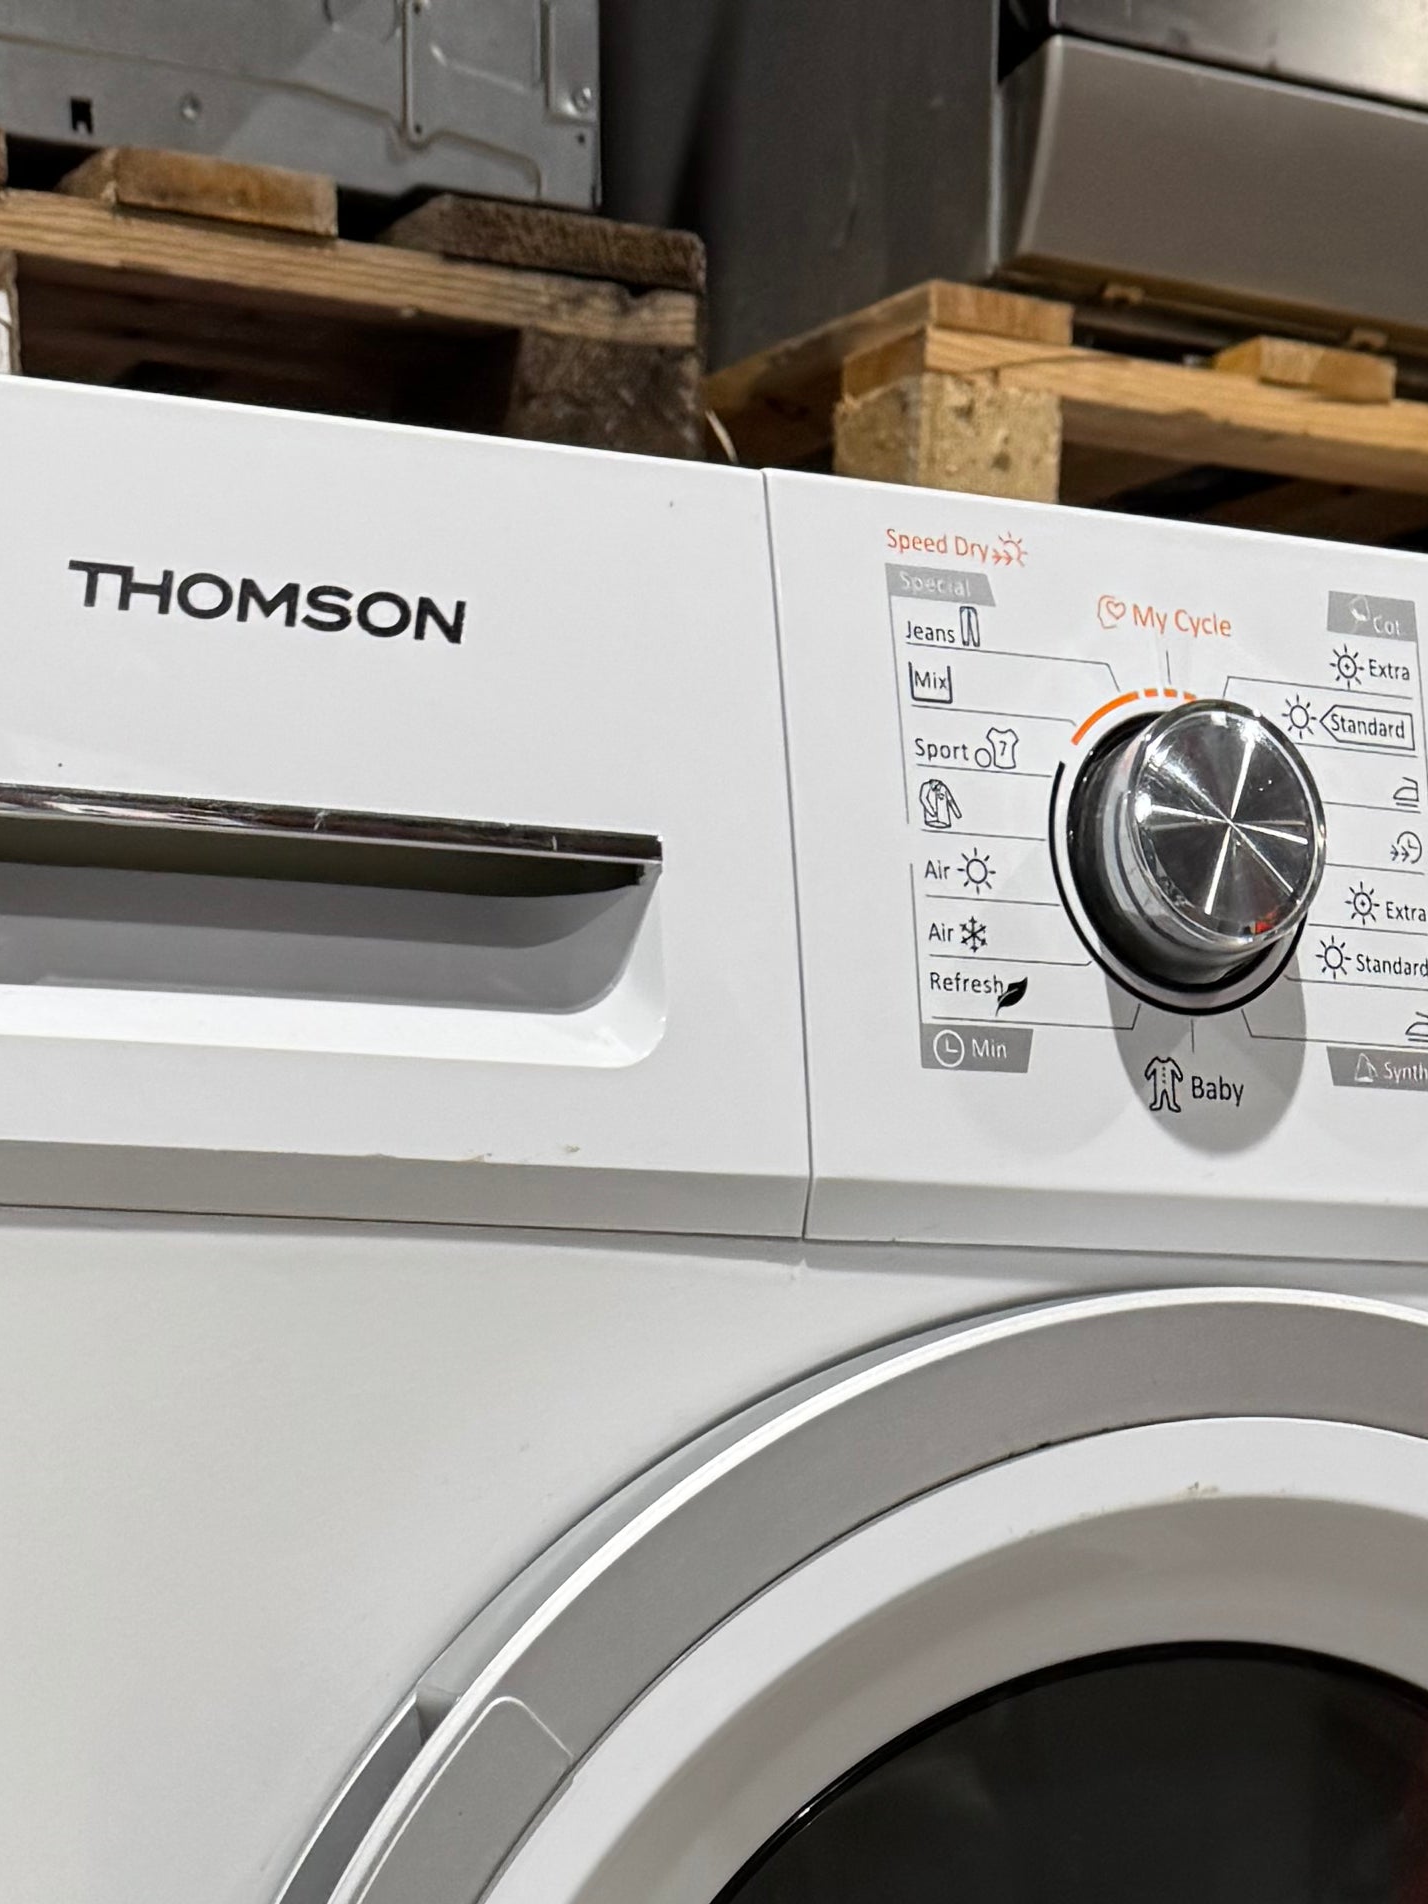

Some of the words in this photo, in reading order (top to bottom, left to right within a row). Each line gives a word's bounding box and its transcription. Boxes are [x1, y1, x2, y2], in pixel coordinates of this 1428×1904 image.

[886, 528, 947, 554] Speed
[954, 535, 989, 563] Dry
[68, 559, 466, 644] THOMSON
[905, 620, 956, 643] Jeans
[1132, 603, 1168, 635] My
[1174, 608, 1232, 637] Cycle
[913, 669, 947, 690] Mix
[1368, 658, 1411, 681] Extra
[1329, 712, 1406, 739] Standard
[914, 737, 970, 762] Sport
[924, 859, 951, 880] Air
[1385, 901, 1427, 922] Extra
[928, 922, 954, 942] Air
[929, 971, 1005, 994] Refresh
[971, 1037, 1007, 1060] Min
[1191, 1075, 1244, 1107] Baby
